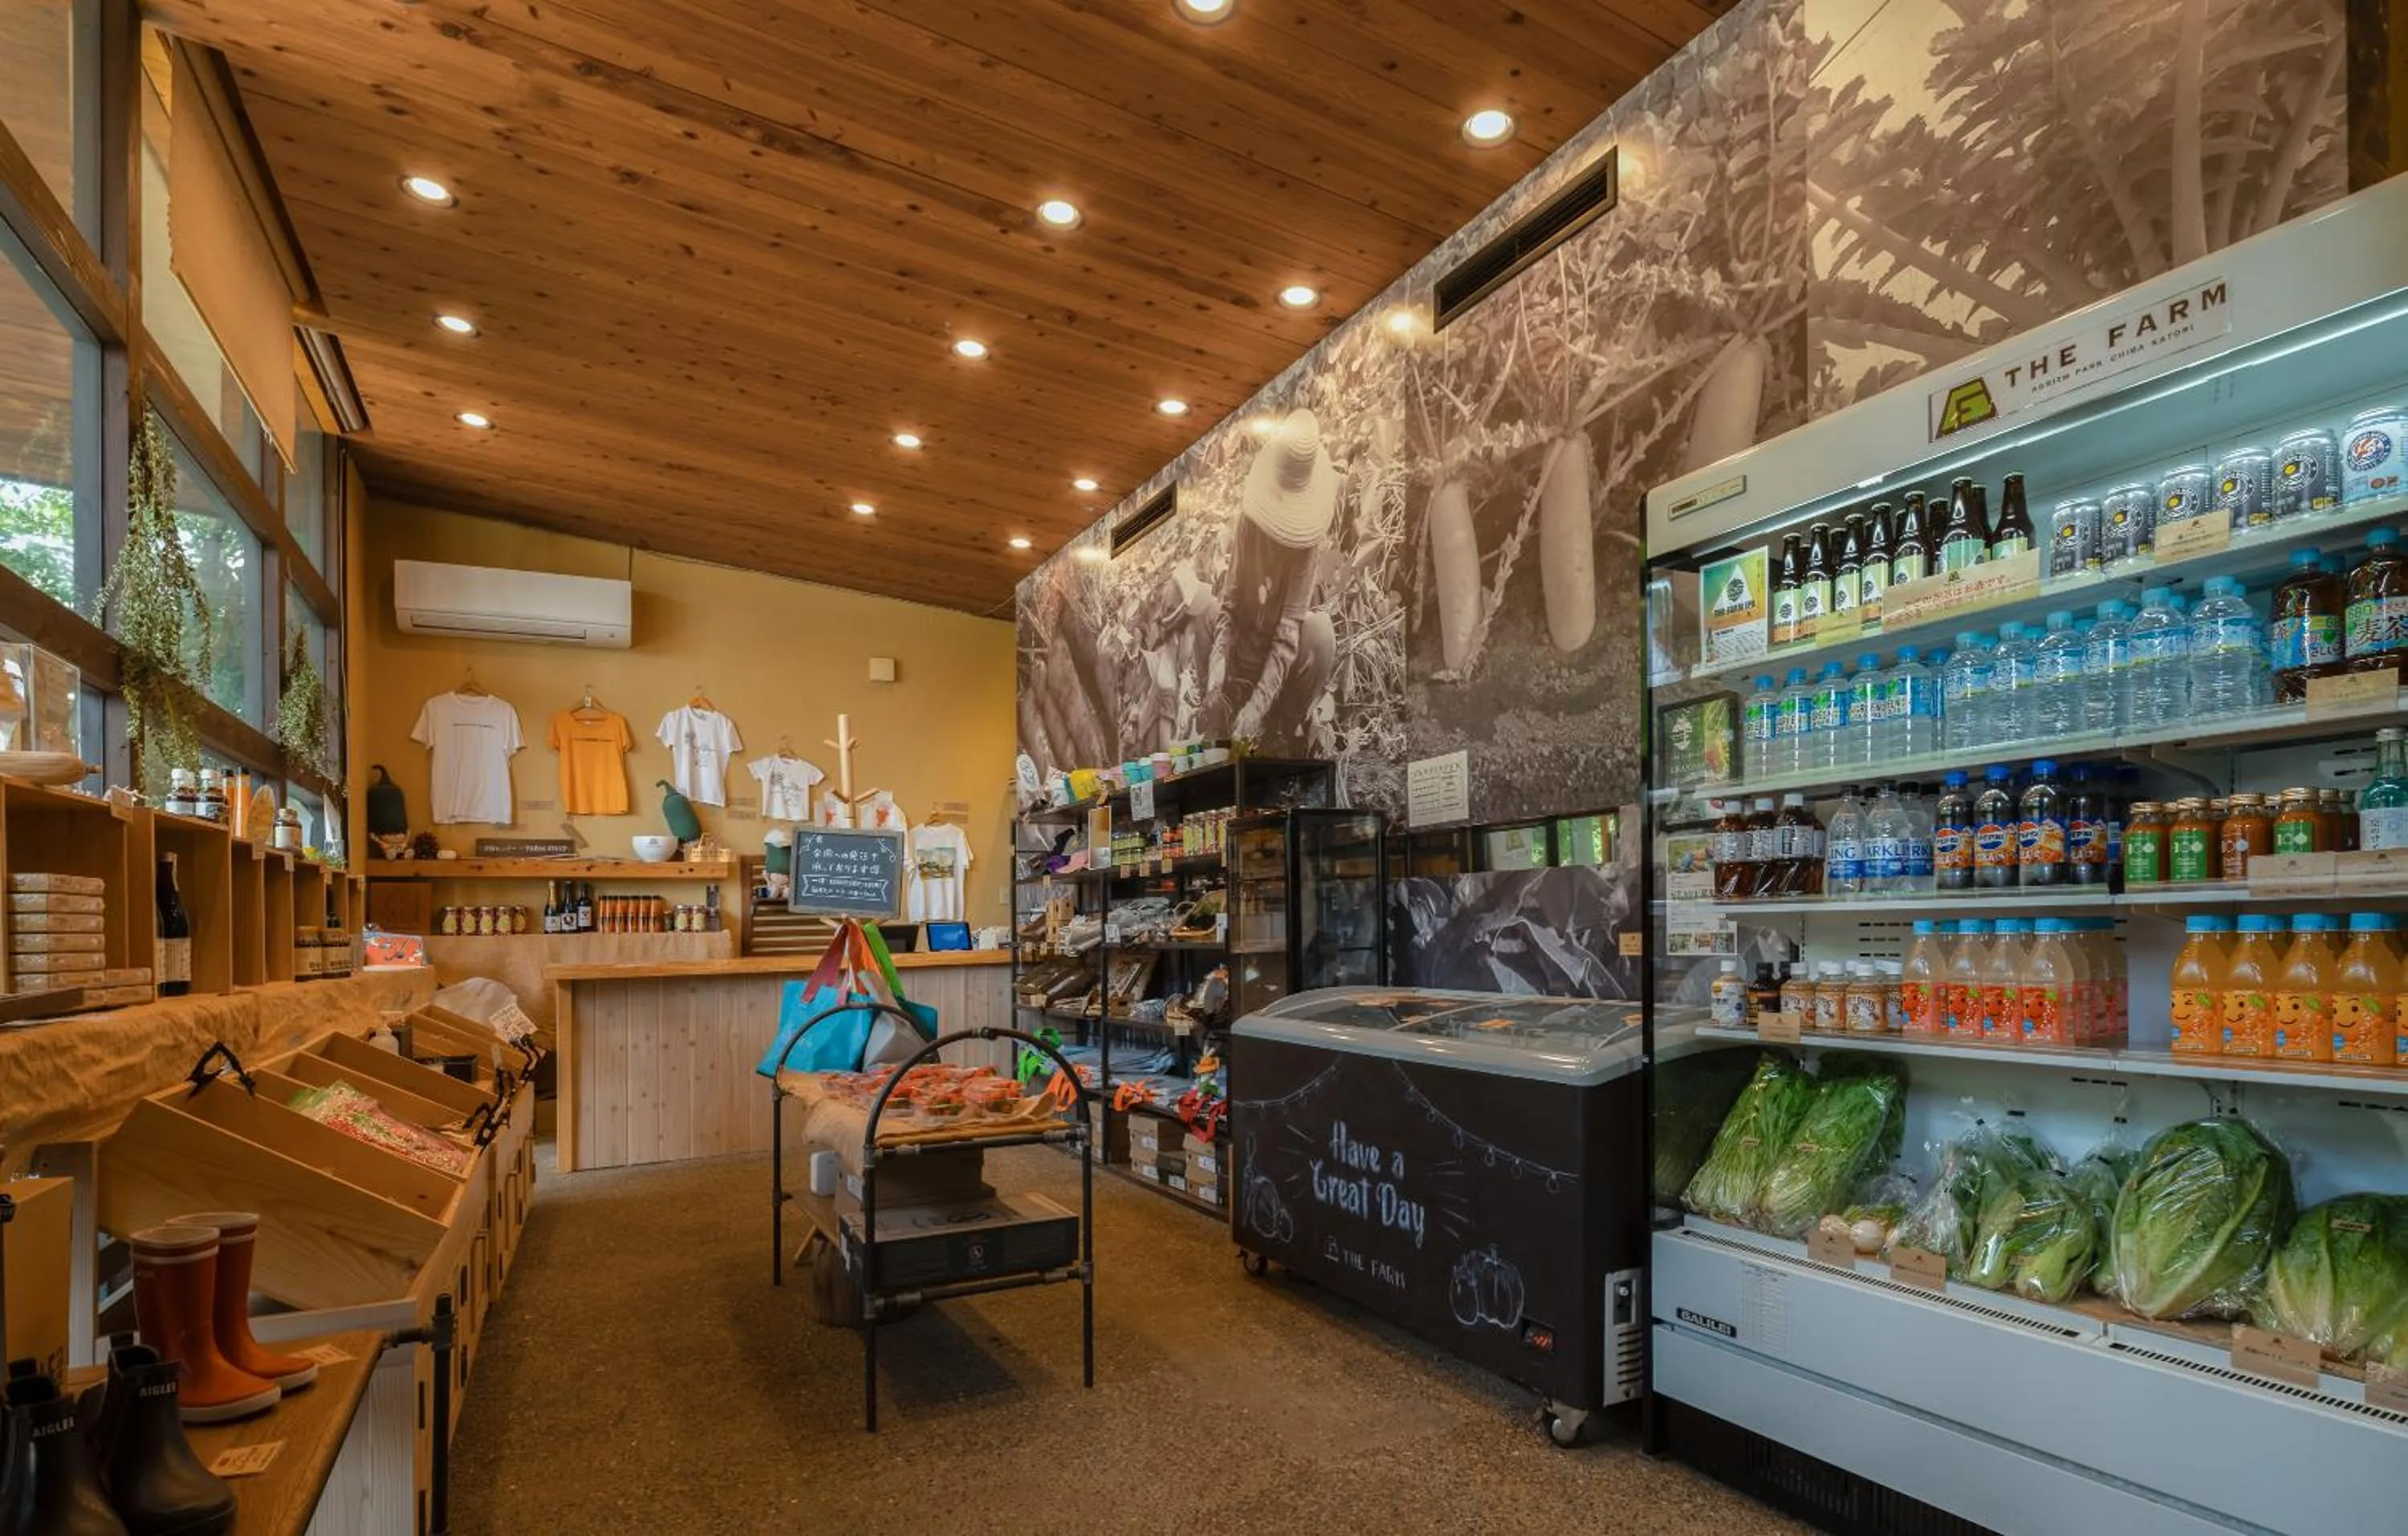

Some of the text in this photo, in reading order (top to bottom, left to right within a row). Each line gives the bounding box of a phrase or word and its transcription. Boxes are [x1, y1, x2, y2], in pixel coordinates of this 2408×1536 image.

[2004, 282, 2228, 388] THE FARM
[2075, 360, 2103, 376] PARK
[1328, 1120, 1405, 1180] Have a
[1309, 1158, 1425, 1250] Great Day
[1681, 1310, 1732, 1336] GALILEI
